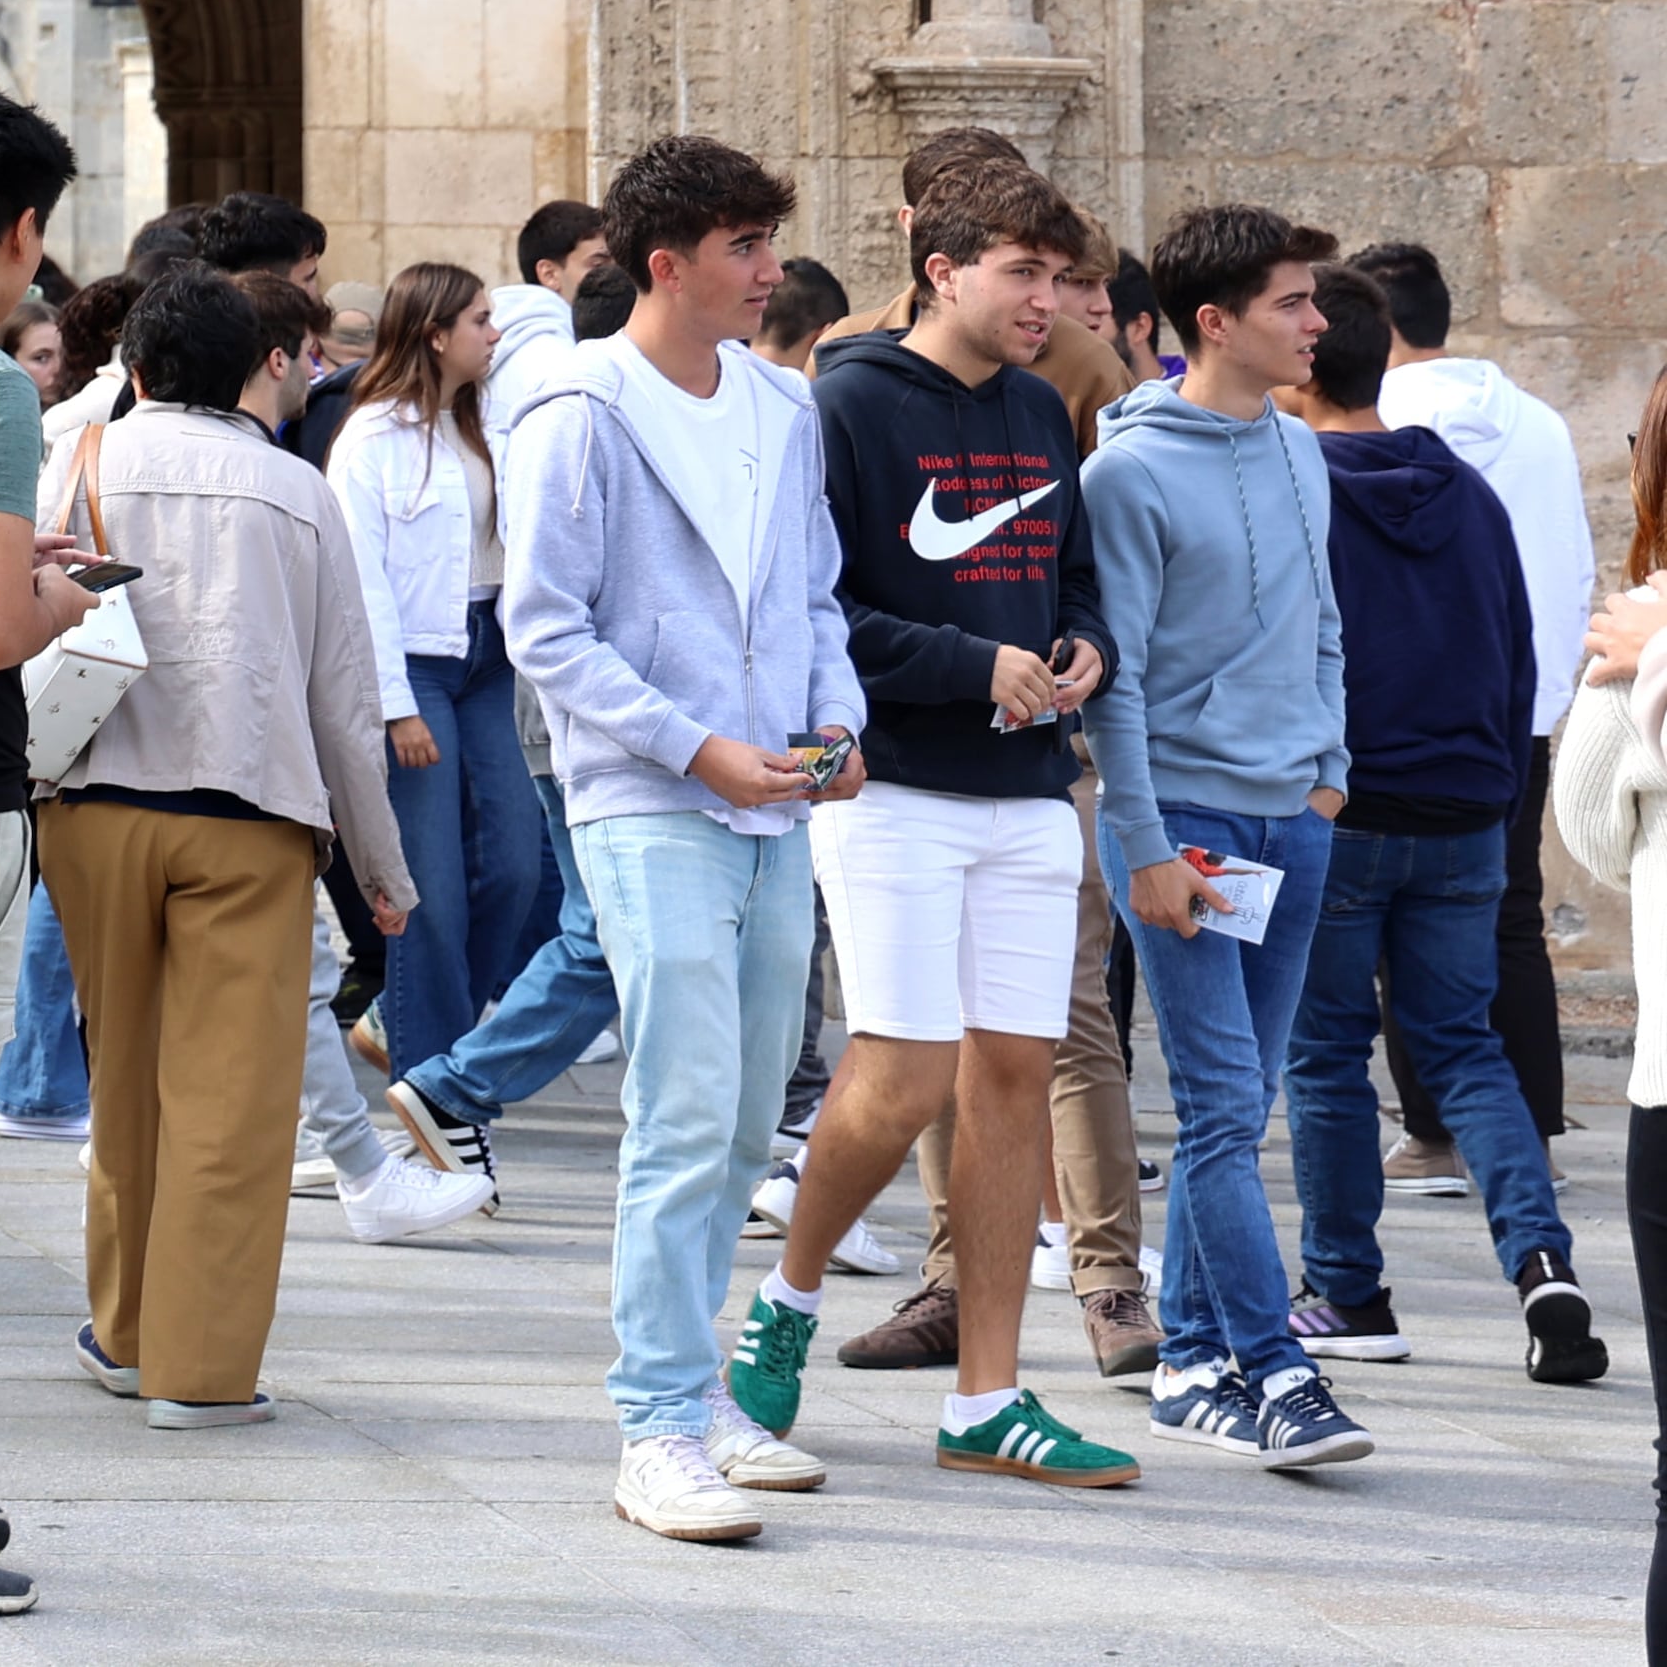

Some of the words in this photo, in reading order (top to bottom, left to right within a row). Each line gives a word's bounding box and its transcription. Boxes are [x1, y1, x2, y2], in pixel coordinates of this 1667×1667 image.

[917, 455, 954, 470] Nike
[991, 475, 1004, 490] of
[1013, 520, 1051, 536] 97005
